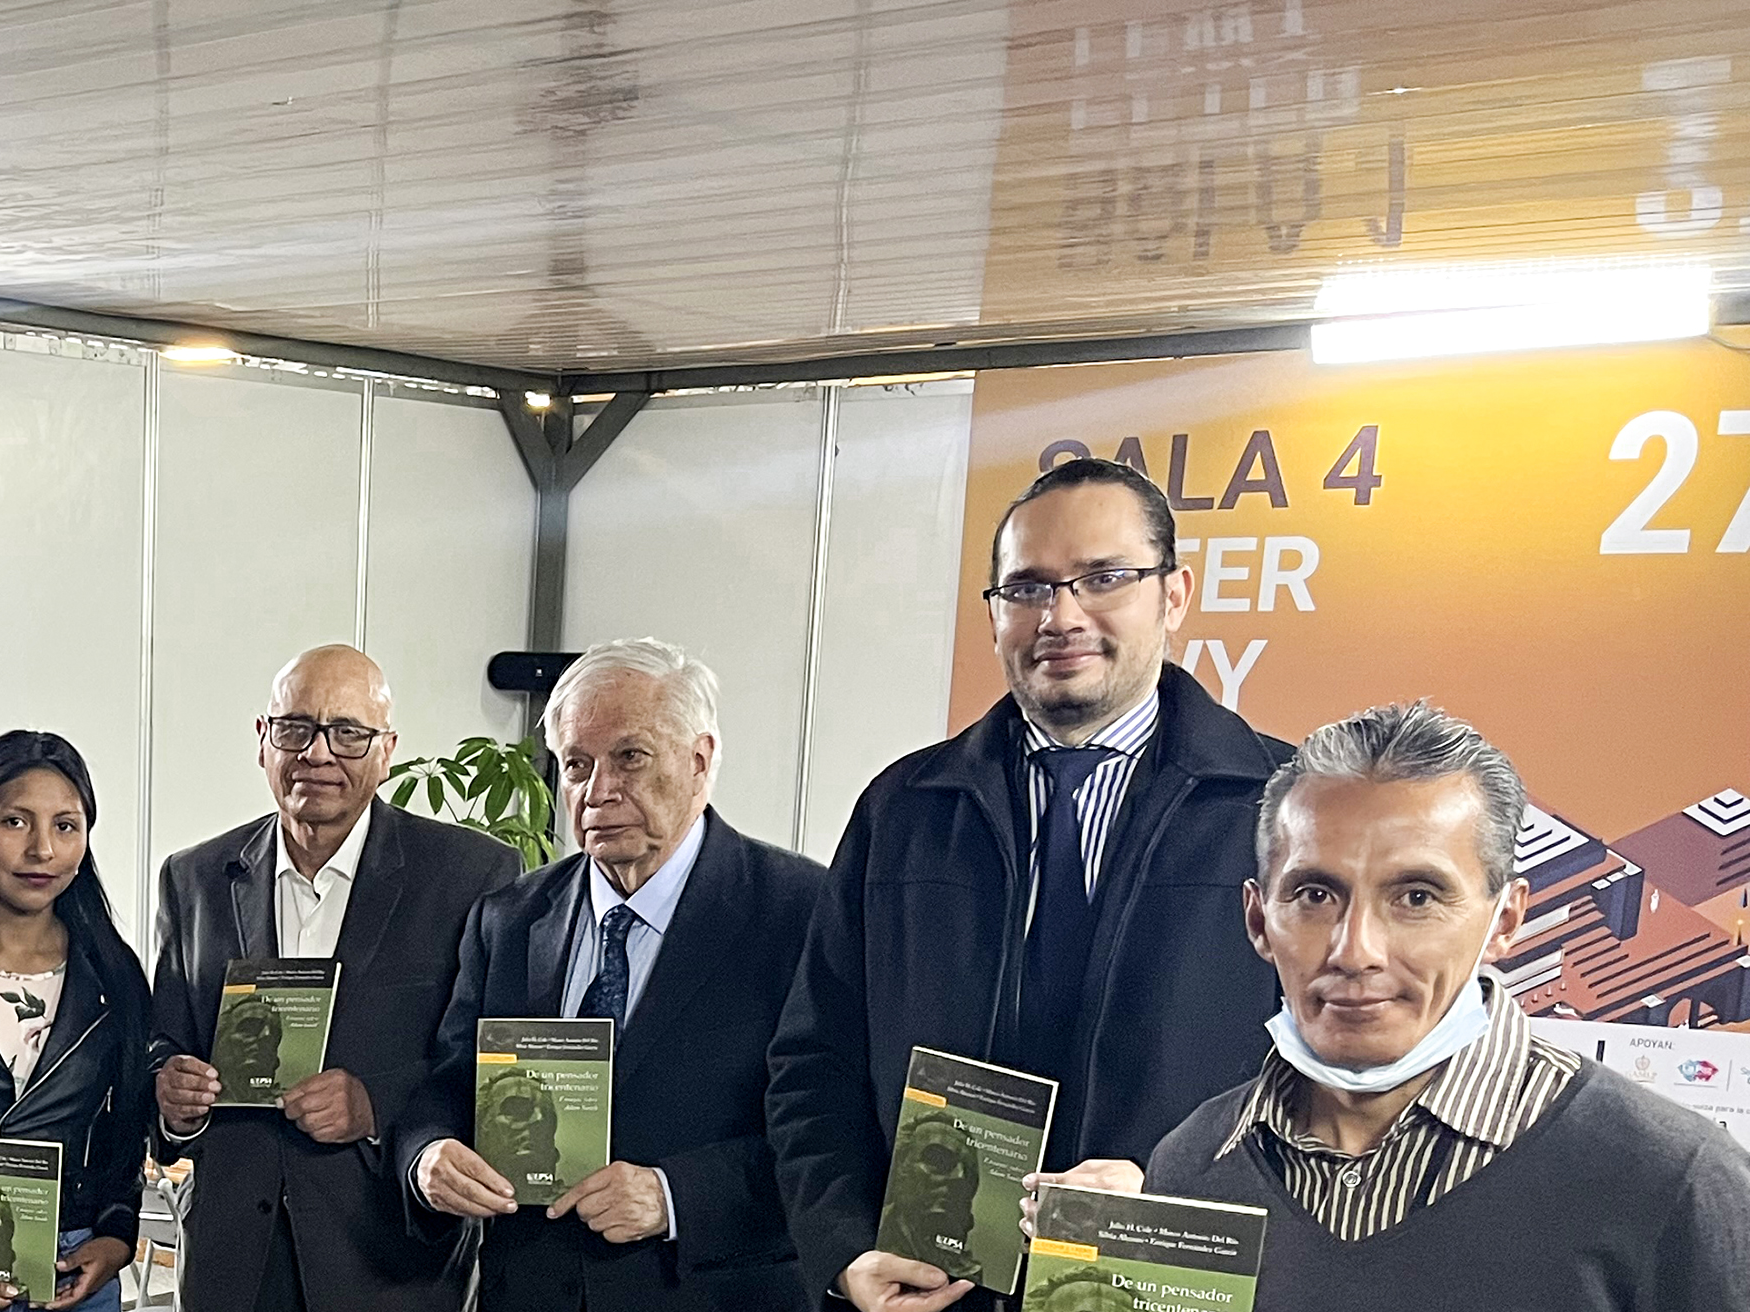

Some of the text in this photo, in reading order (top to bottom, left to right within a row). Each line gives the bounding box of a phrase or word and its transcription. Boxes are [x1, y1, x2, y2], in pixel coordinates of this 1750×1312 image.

[1323, 424, 1382, 506] 4
[1111, 1274, 1233, 1303] De un pensador
